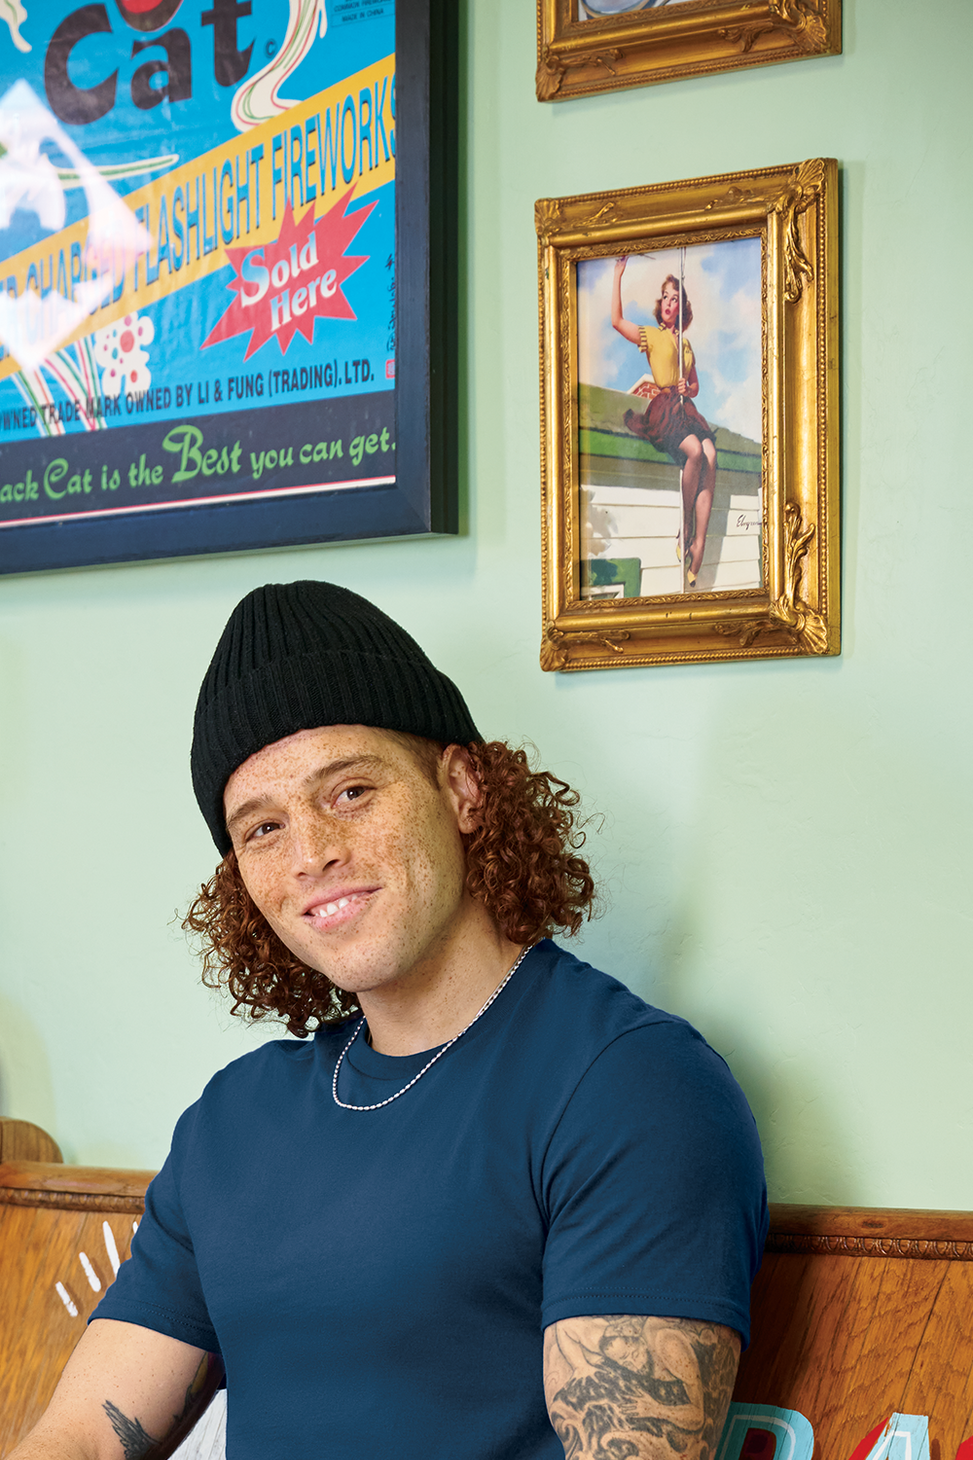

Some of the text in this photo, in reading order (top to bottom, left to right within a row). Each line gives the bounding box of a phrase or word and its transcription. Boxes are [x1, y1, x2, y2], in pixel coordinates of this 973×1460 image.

[44, 0, 256, 125] Cat
[134, 142, 265, 292] FLASHLIGHT
[240, 230, 319, 308] Sold
[270, 269, 337, 332] Here
[41, 398, 80, 425] TRADE
[86, 393, 122, 419] MARK
[127, 385, 172, 414] OWNED
[176, 382, 193, 408] BY
[198, 380, 209, 404] LI
[214, 379, 223, 402] &
[228, 373, 264, 400] FUNG
[345, 358, 374, 385] LTD.
[43, 458, 93, 500] Cat
[101, 464, 121, 491] is
[128, 453, 164, 488] the
[162, 424, 243, 484] Best
[250, 446, 294, 480] you
[299, 439, 344, 465] can
[349, 426, 396, 466] get.
